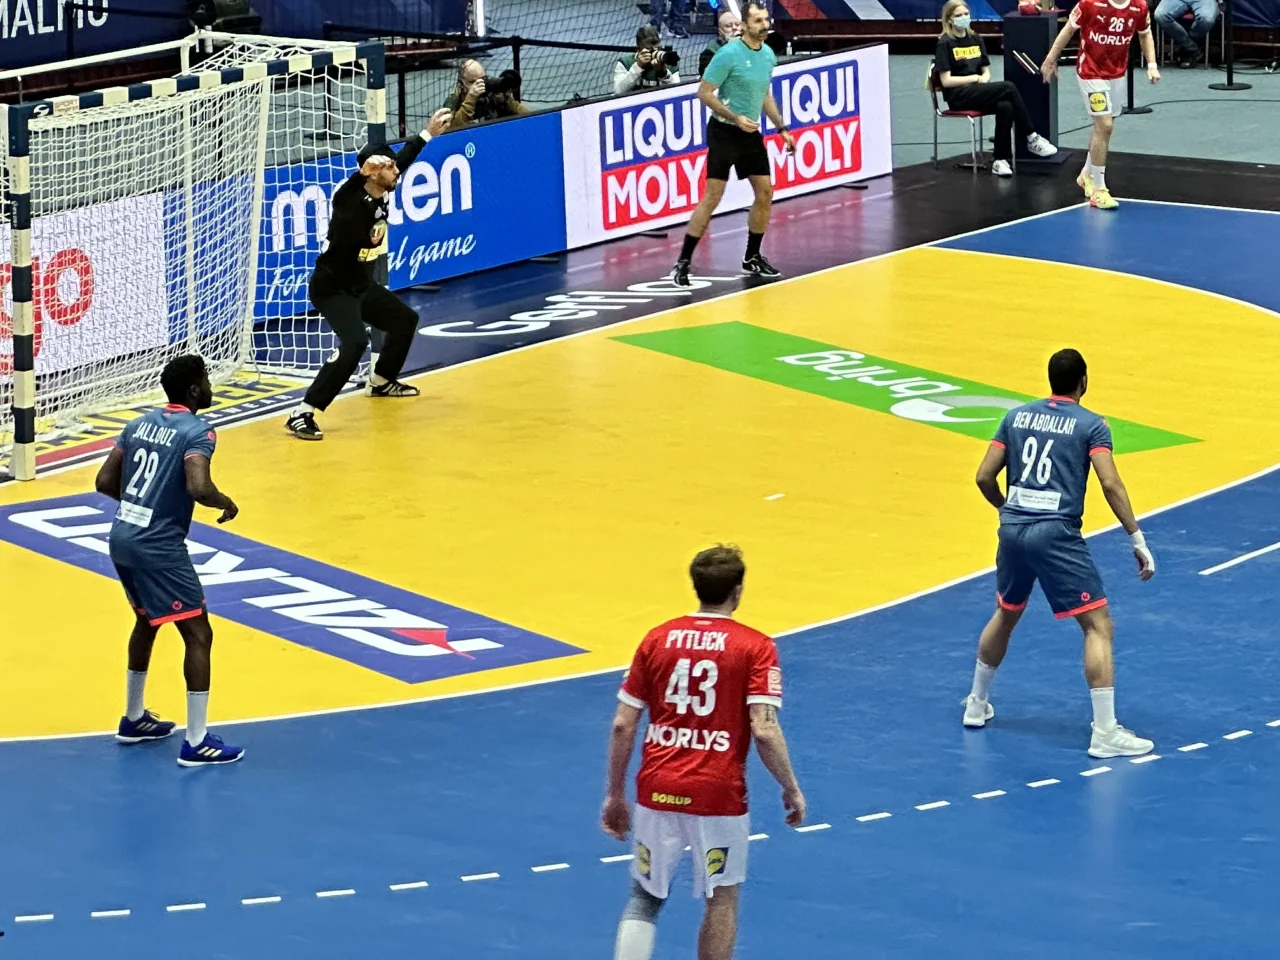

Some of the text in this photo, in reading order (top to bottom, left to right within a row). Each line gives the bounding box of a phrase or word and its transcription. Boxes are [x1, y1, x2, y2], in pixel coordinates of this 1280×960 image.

[1109, 17, 1124, 32] 26
[604, 98, 702, 165] LIQUI
[768, 121, 859, 186] MOLY
[606, 154, 707, 224] MOLY
[409, 233, 477, 281] game
[774, 350, 963, 398] bring
[132, 420, 178, 448] JALLOUZ
[1012, 411, 1078, 436] BEN ABDALLAH
[125, 447, 160, 498] 29
[1020, 436, 1054, 486] 96
[665, 628, 730, 652] PYTLICK
[664, 658, 719, 717] 43
[645, 724, 731, 753] NORLYS
